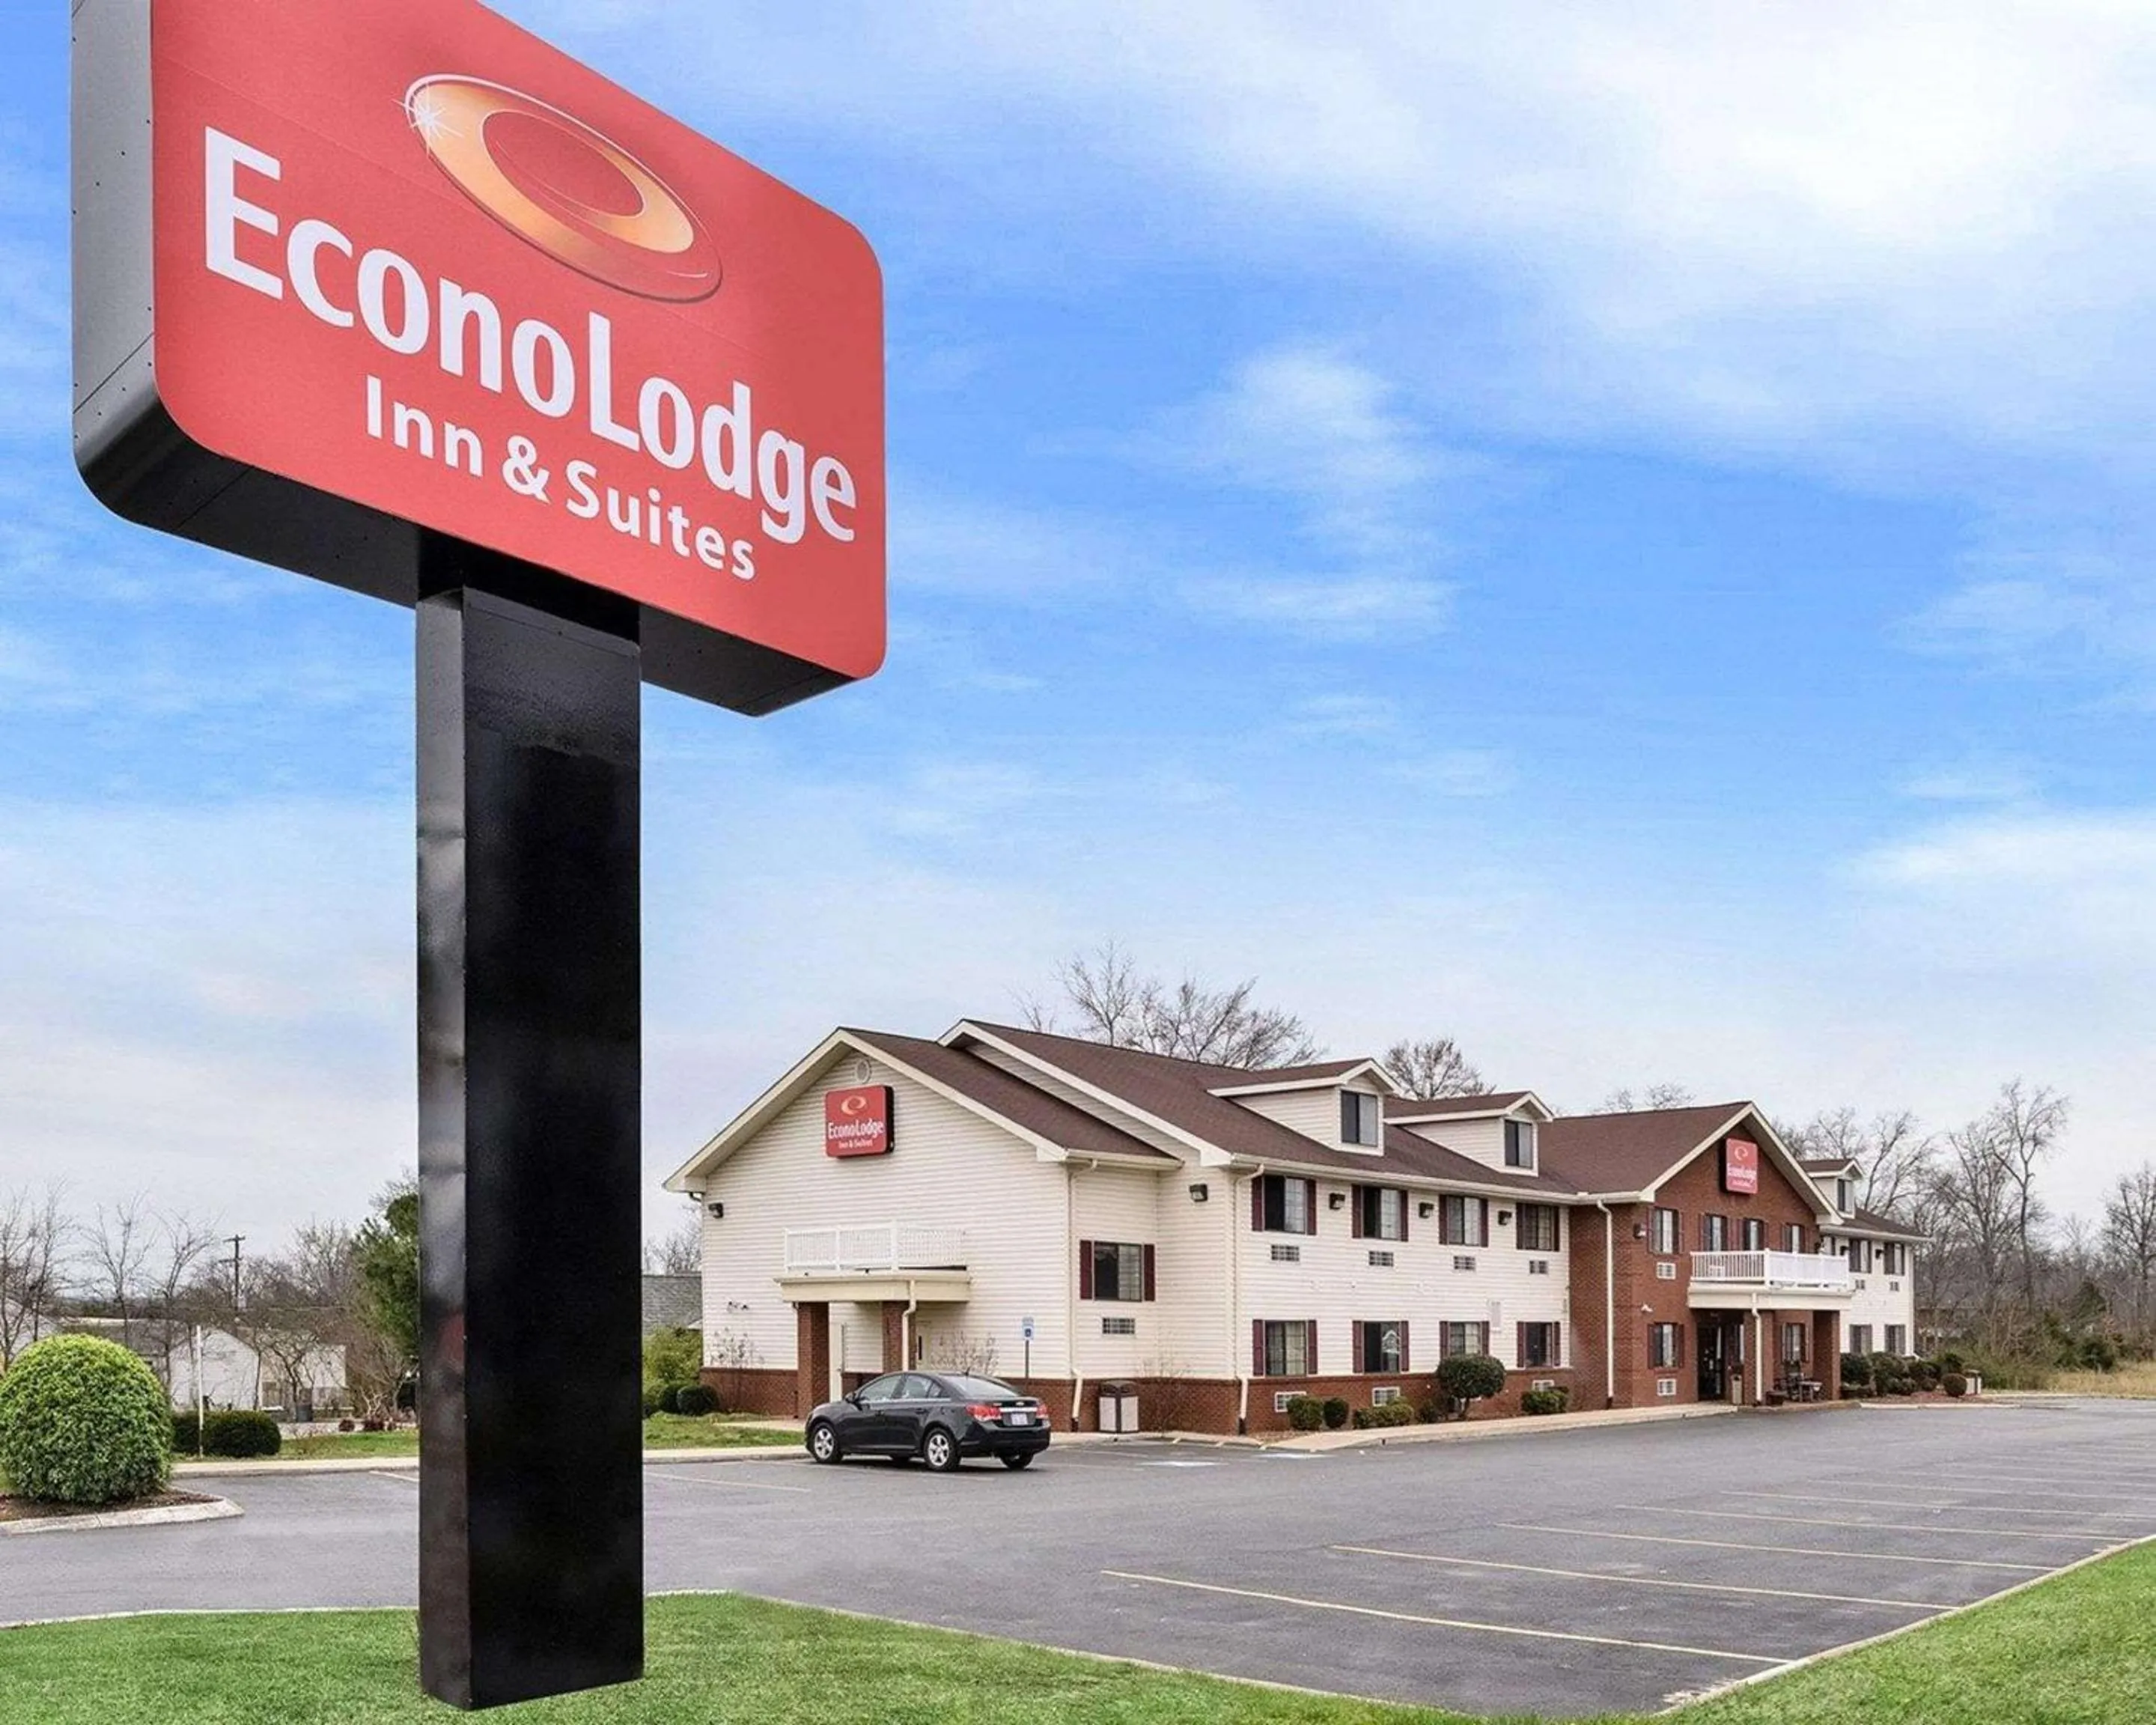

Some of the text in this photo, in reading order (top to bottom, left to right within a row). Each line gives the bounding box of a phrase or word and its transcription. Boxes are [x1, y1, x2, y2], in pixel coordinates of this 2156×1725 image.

[204, 126, 856, 544] EconoLodge
[366, 374, 756, 580] Inn & Suites
